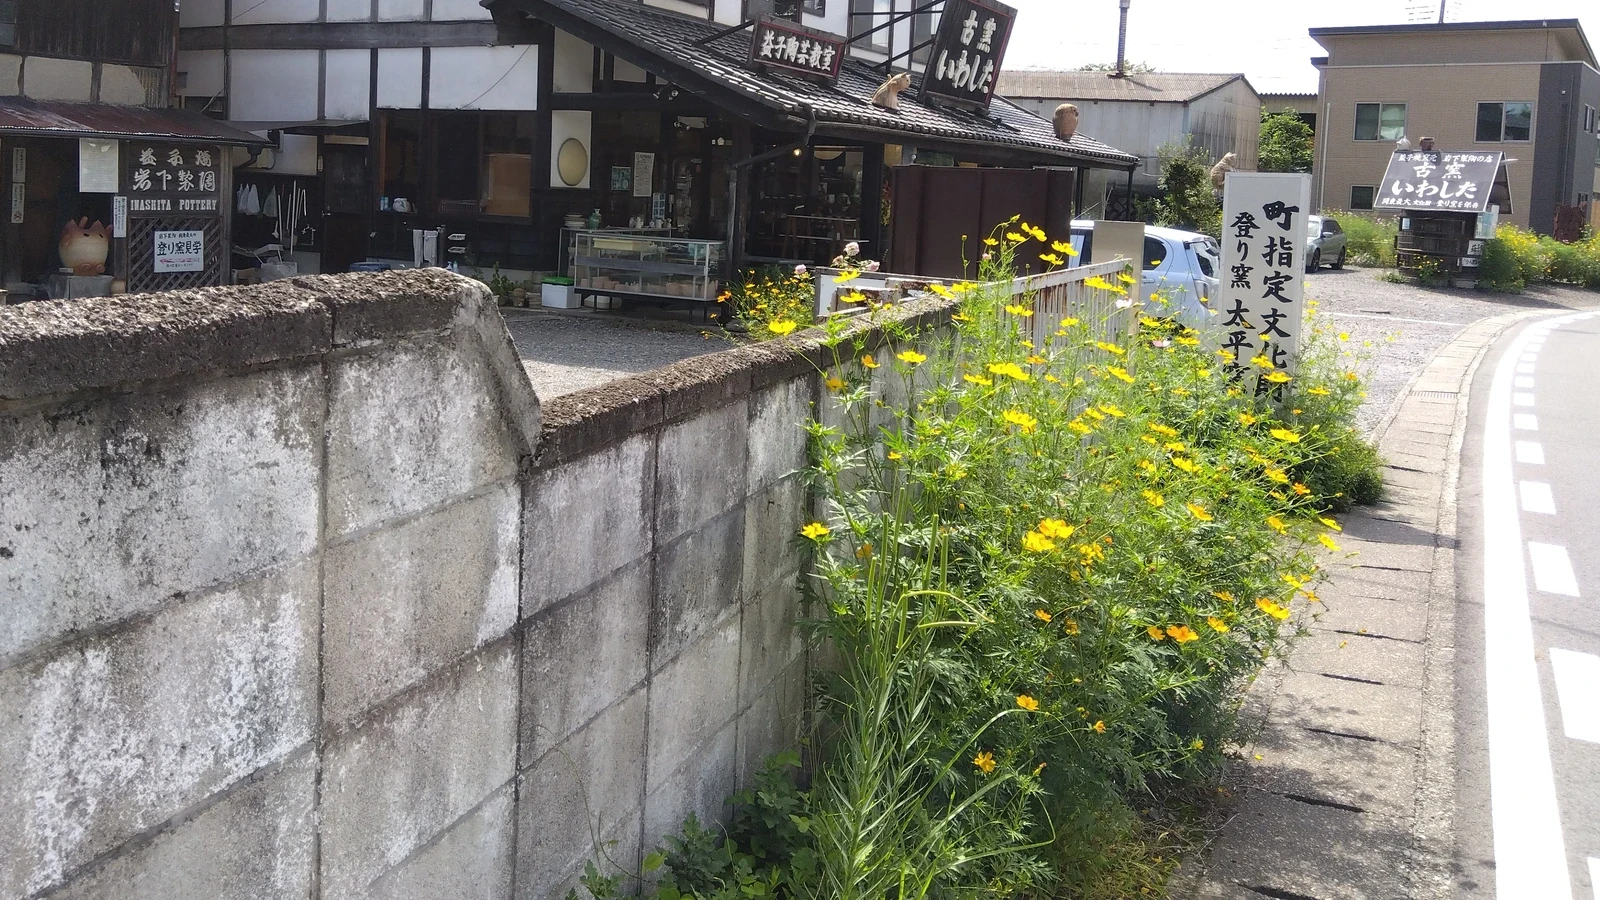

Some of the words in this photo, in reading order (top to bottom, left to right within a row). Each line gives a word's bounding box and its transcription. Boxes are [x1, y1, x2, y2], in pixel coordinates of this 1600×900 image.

[759, 29, 836, 71] 益子陶芸教室
[935, 48, 994, 93] いわした
[1413, 162, 1466, 179] 古窯
[1391, 180, 1478, 199] いわした
[179, 199, 217, 211] POTTERY
[156, 240, 202, 256] 登り窯見学
[1230, 211, 1261, 290] 登り窯
